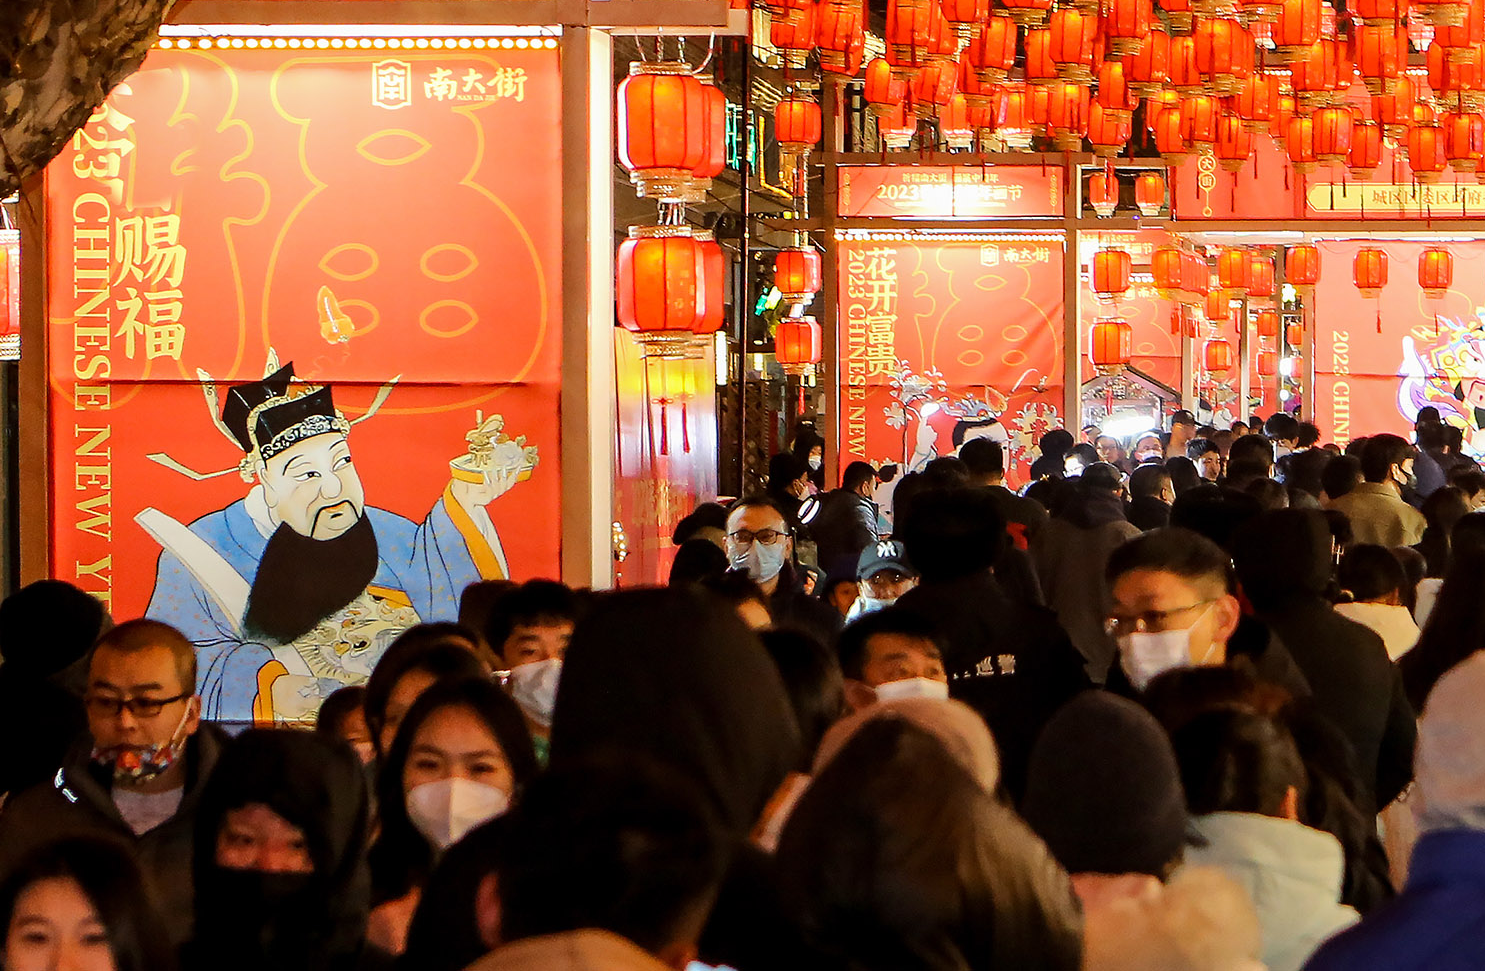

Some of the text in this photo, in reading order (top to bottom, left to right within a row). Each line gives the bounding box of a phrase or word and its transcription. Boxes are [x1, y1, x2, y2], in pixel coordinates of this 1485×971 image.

[424, 67, 528, 102] 南大街
[73, 192, 112, 411] CHINESE
[864, 246, 898, 377] 花开富贵
[1003, 247, 1050, 263] 南大街
[848, 249, 866, 457] 2023 CHINESE NEW
[1333, 330, 1351, 448] 2023 CHINE
[75, 424, 111, 542] NEW
[76, 554, 112, 614] YE
